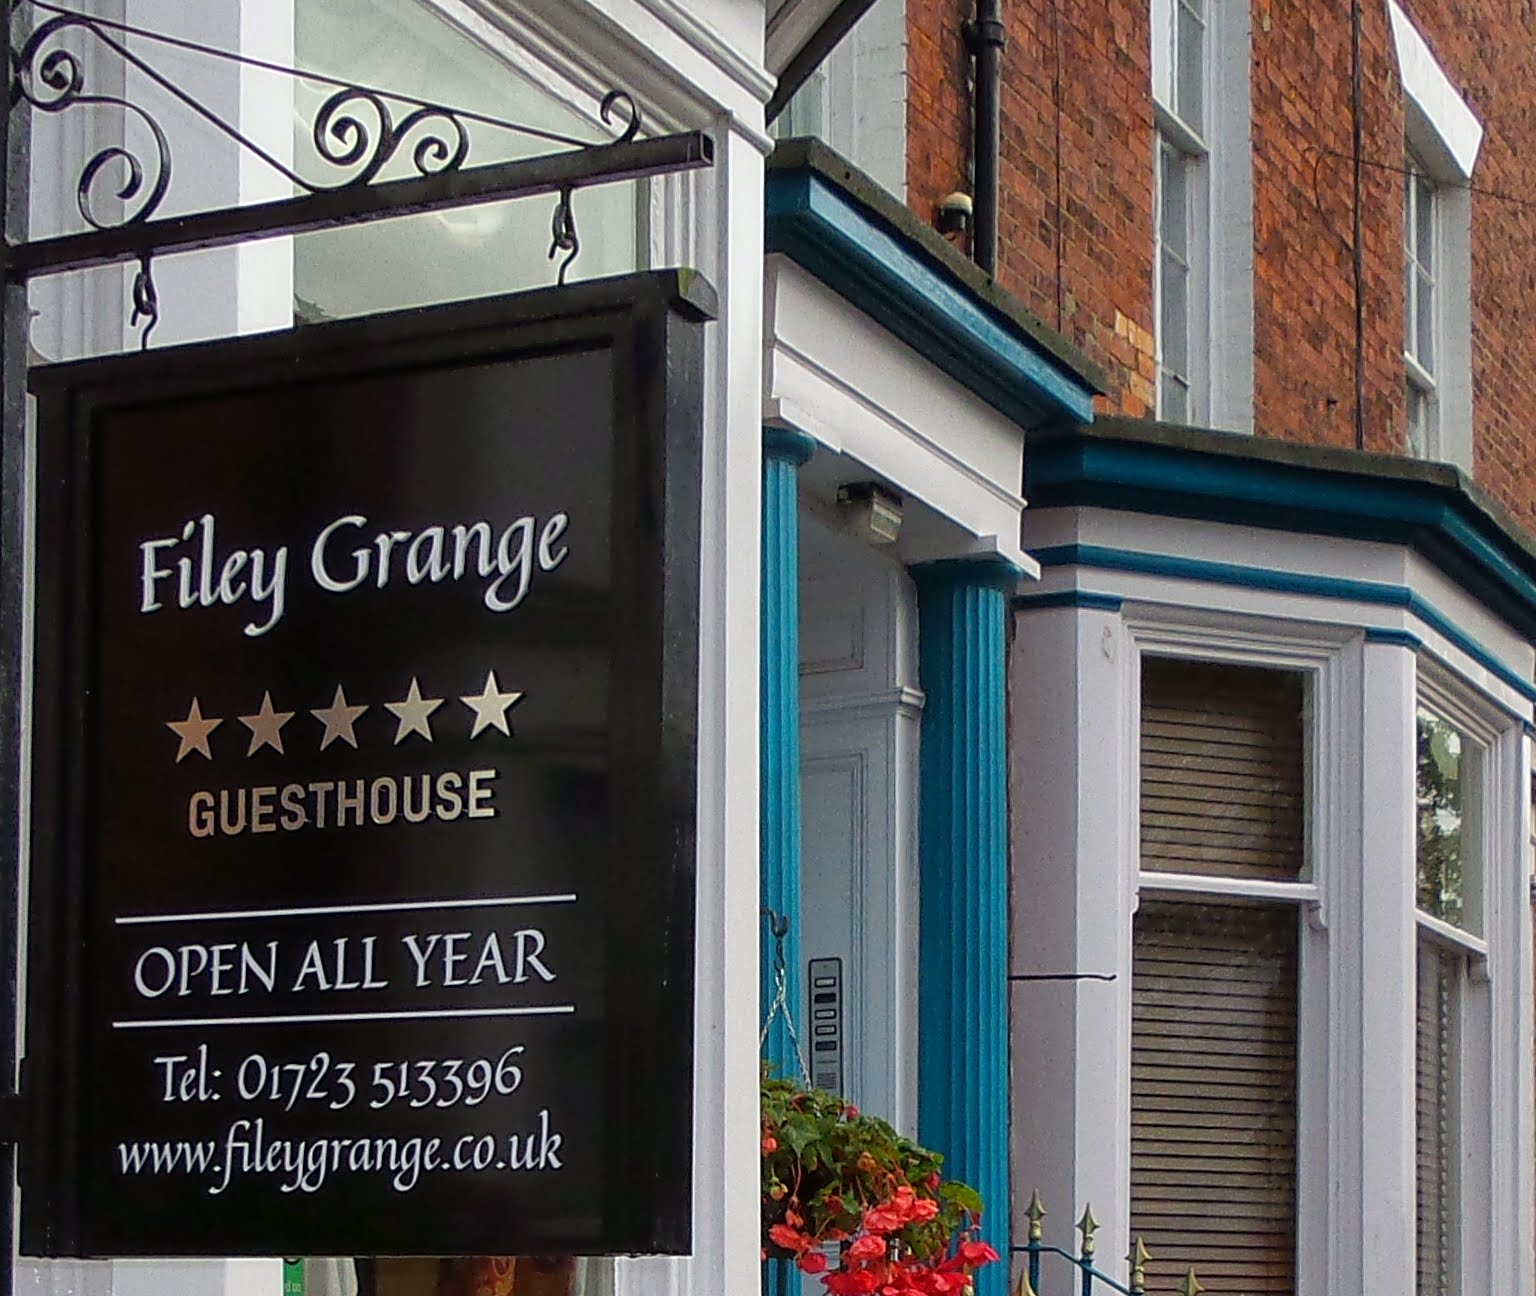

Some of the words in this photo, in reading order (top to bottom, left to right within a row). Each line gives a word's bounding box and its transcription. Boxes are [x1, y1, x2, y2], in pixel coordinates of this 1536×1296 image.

[138, 512, 288, 637] Filey
[311, 511, 569, 613] Grange
[188, 768, 499, 838] GUESTHOUSE
[134, 941, 279, 998] OPEN
[292, 935, 389, 992] ALL
[402, 928, 557, 987] YEAR
[153, 1043, 222, 1102] Tel:
[237, 1052, 356, 1111] 01723
[370, 1046, 526, 1109] 513396
[117, 1109, 564, 1194] www.fileygrange.co.uk
